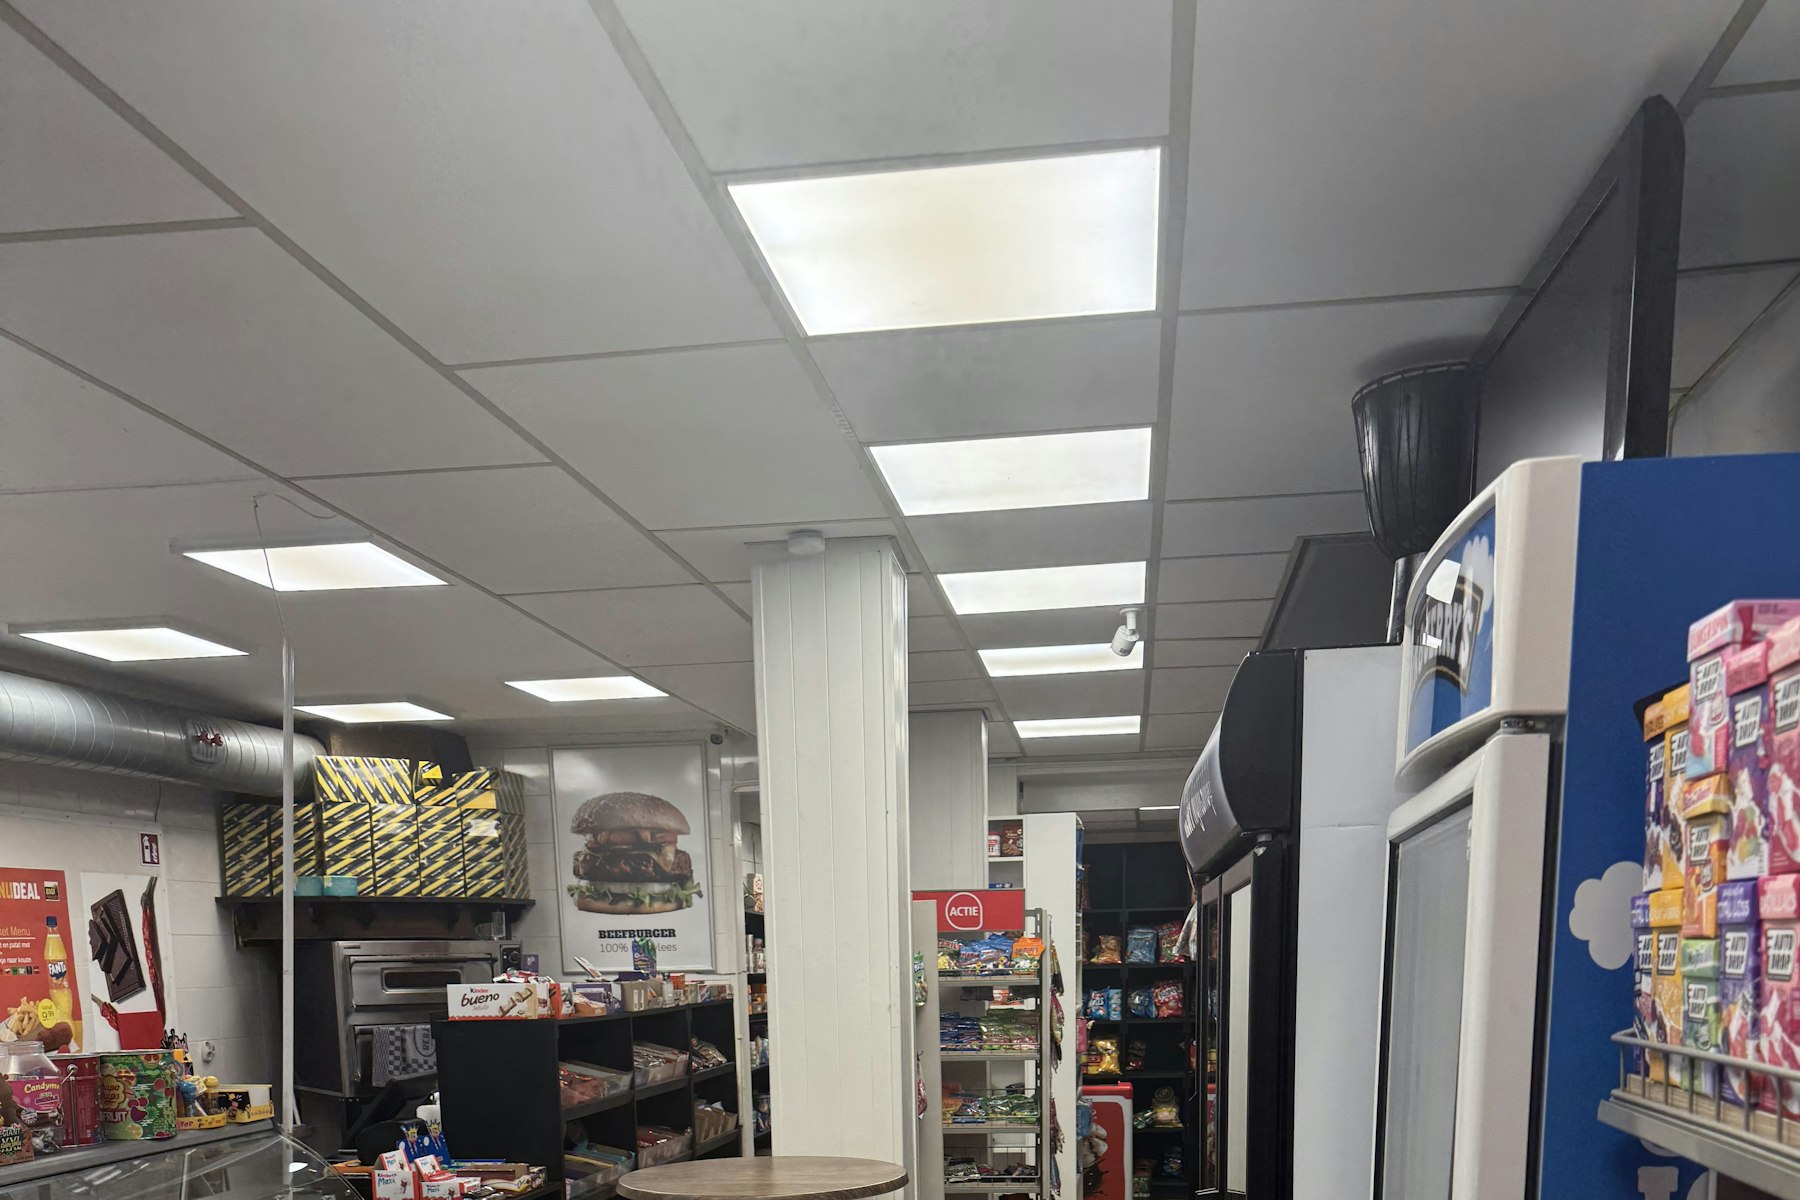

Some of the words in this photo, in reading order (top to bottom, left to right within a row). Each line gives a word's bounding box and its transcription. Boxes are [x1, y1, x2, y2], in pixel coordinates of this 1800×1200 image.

[949, 906, 979, 917] ACTIE
[598, 928, 677, 939] BEEFBURGER
[600, 943, 628, 953] 100%
[655, 943, 678, 952] lees
[461, 993, 500, 1007] bueno
